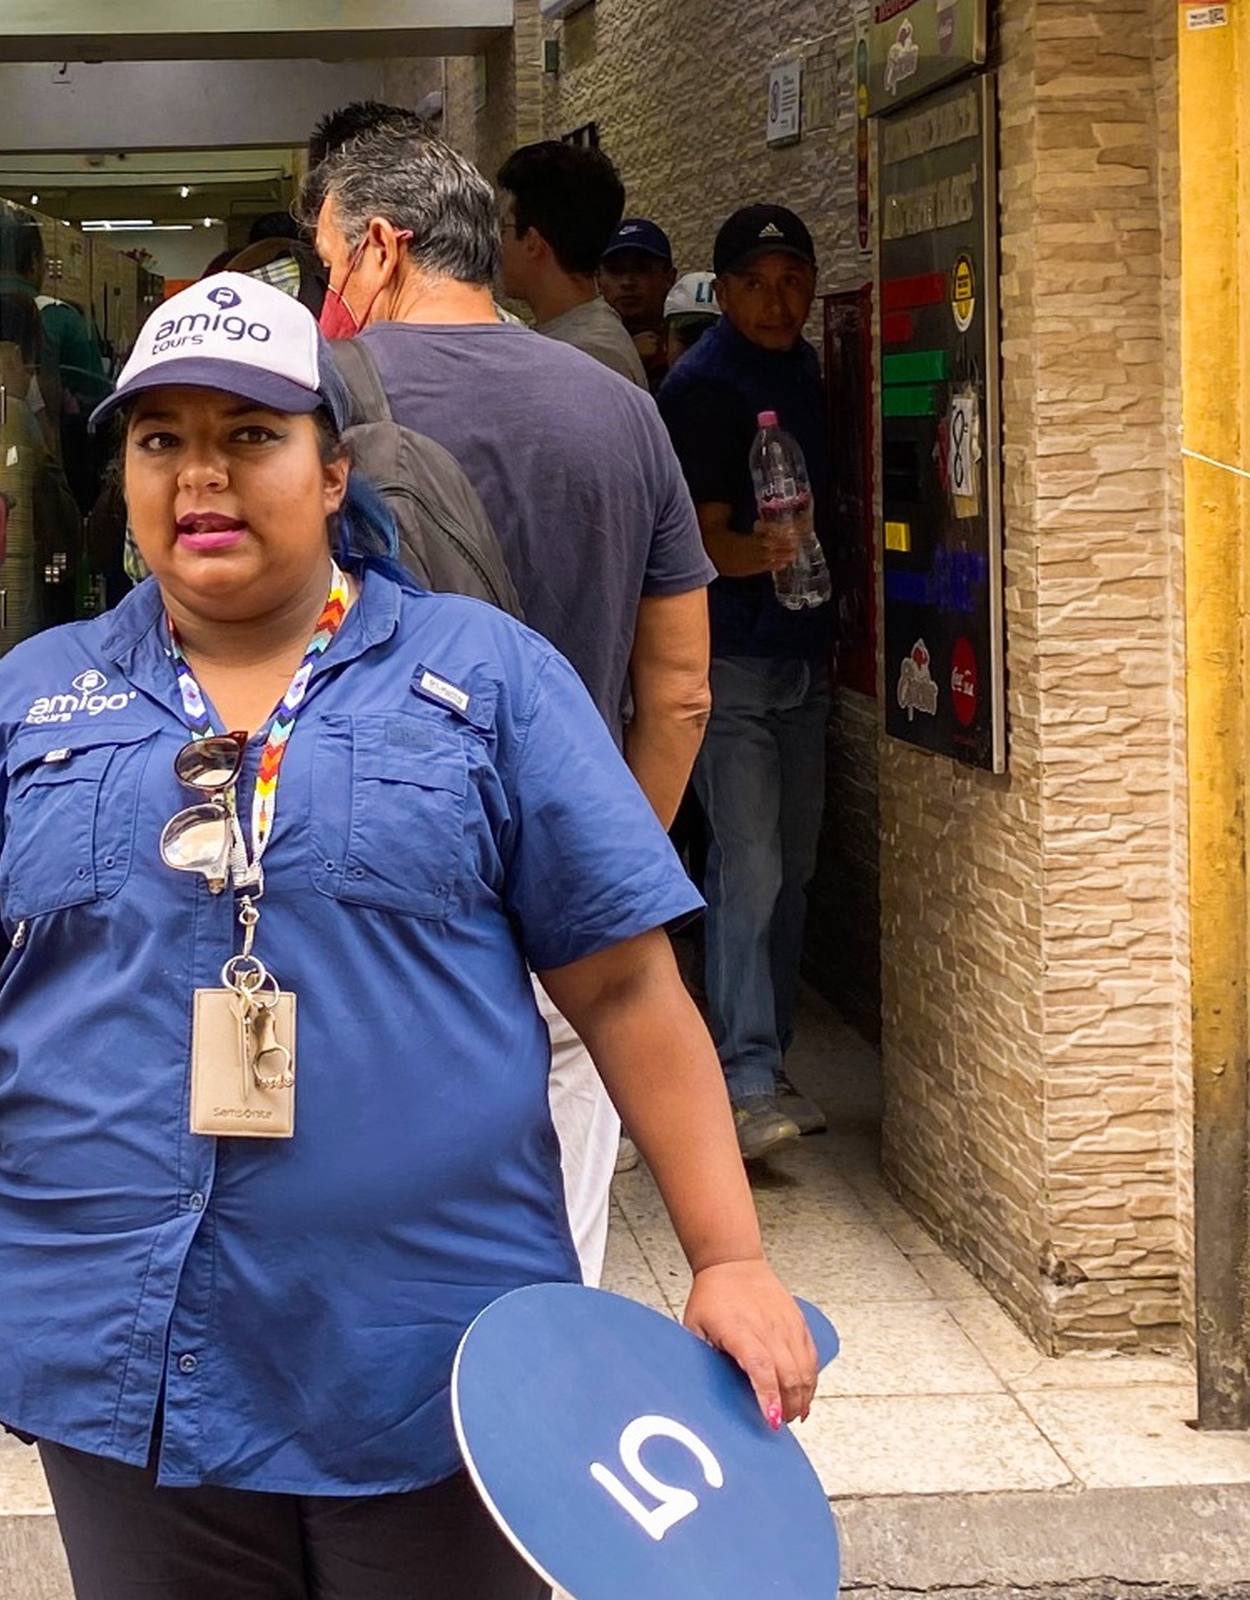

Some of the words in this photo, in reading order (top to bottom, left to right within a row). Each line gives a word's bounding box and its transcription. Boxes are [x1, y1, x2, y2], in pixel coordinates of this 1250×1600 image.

[155, 313, 271, 342] amigo
[152, 334, 204, 355] tours
[25, 712, 72, 724] tours
[589, 1414, 725, 1541] 5
